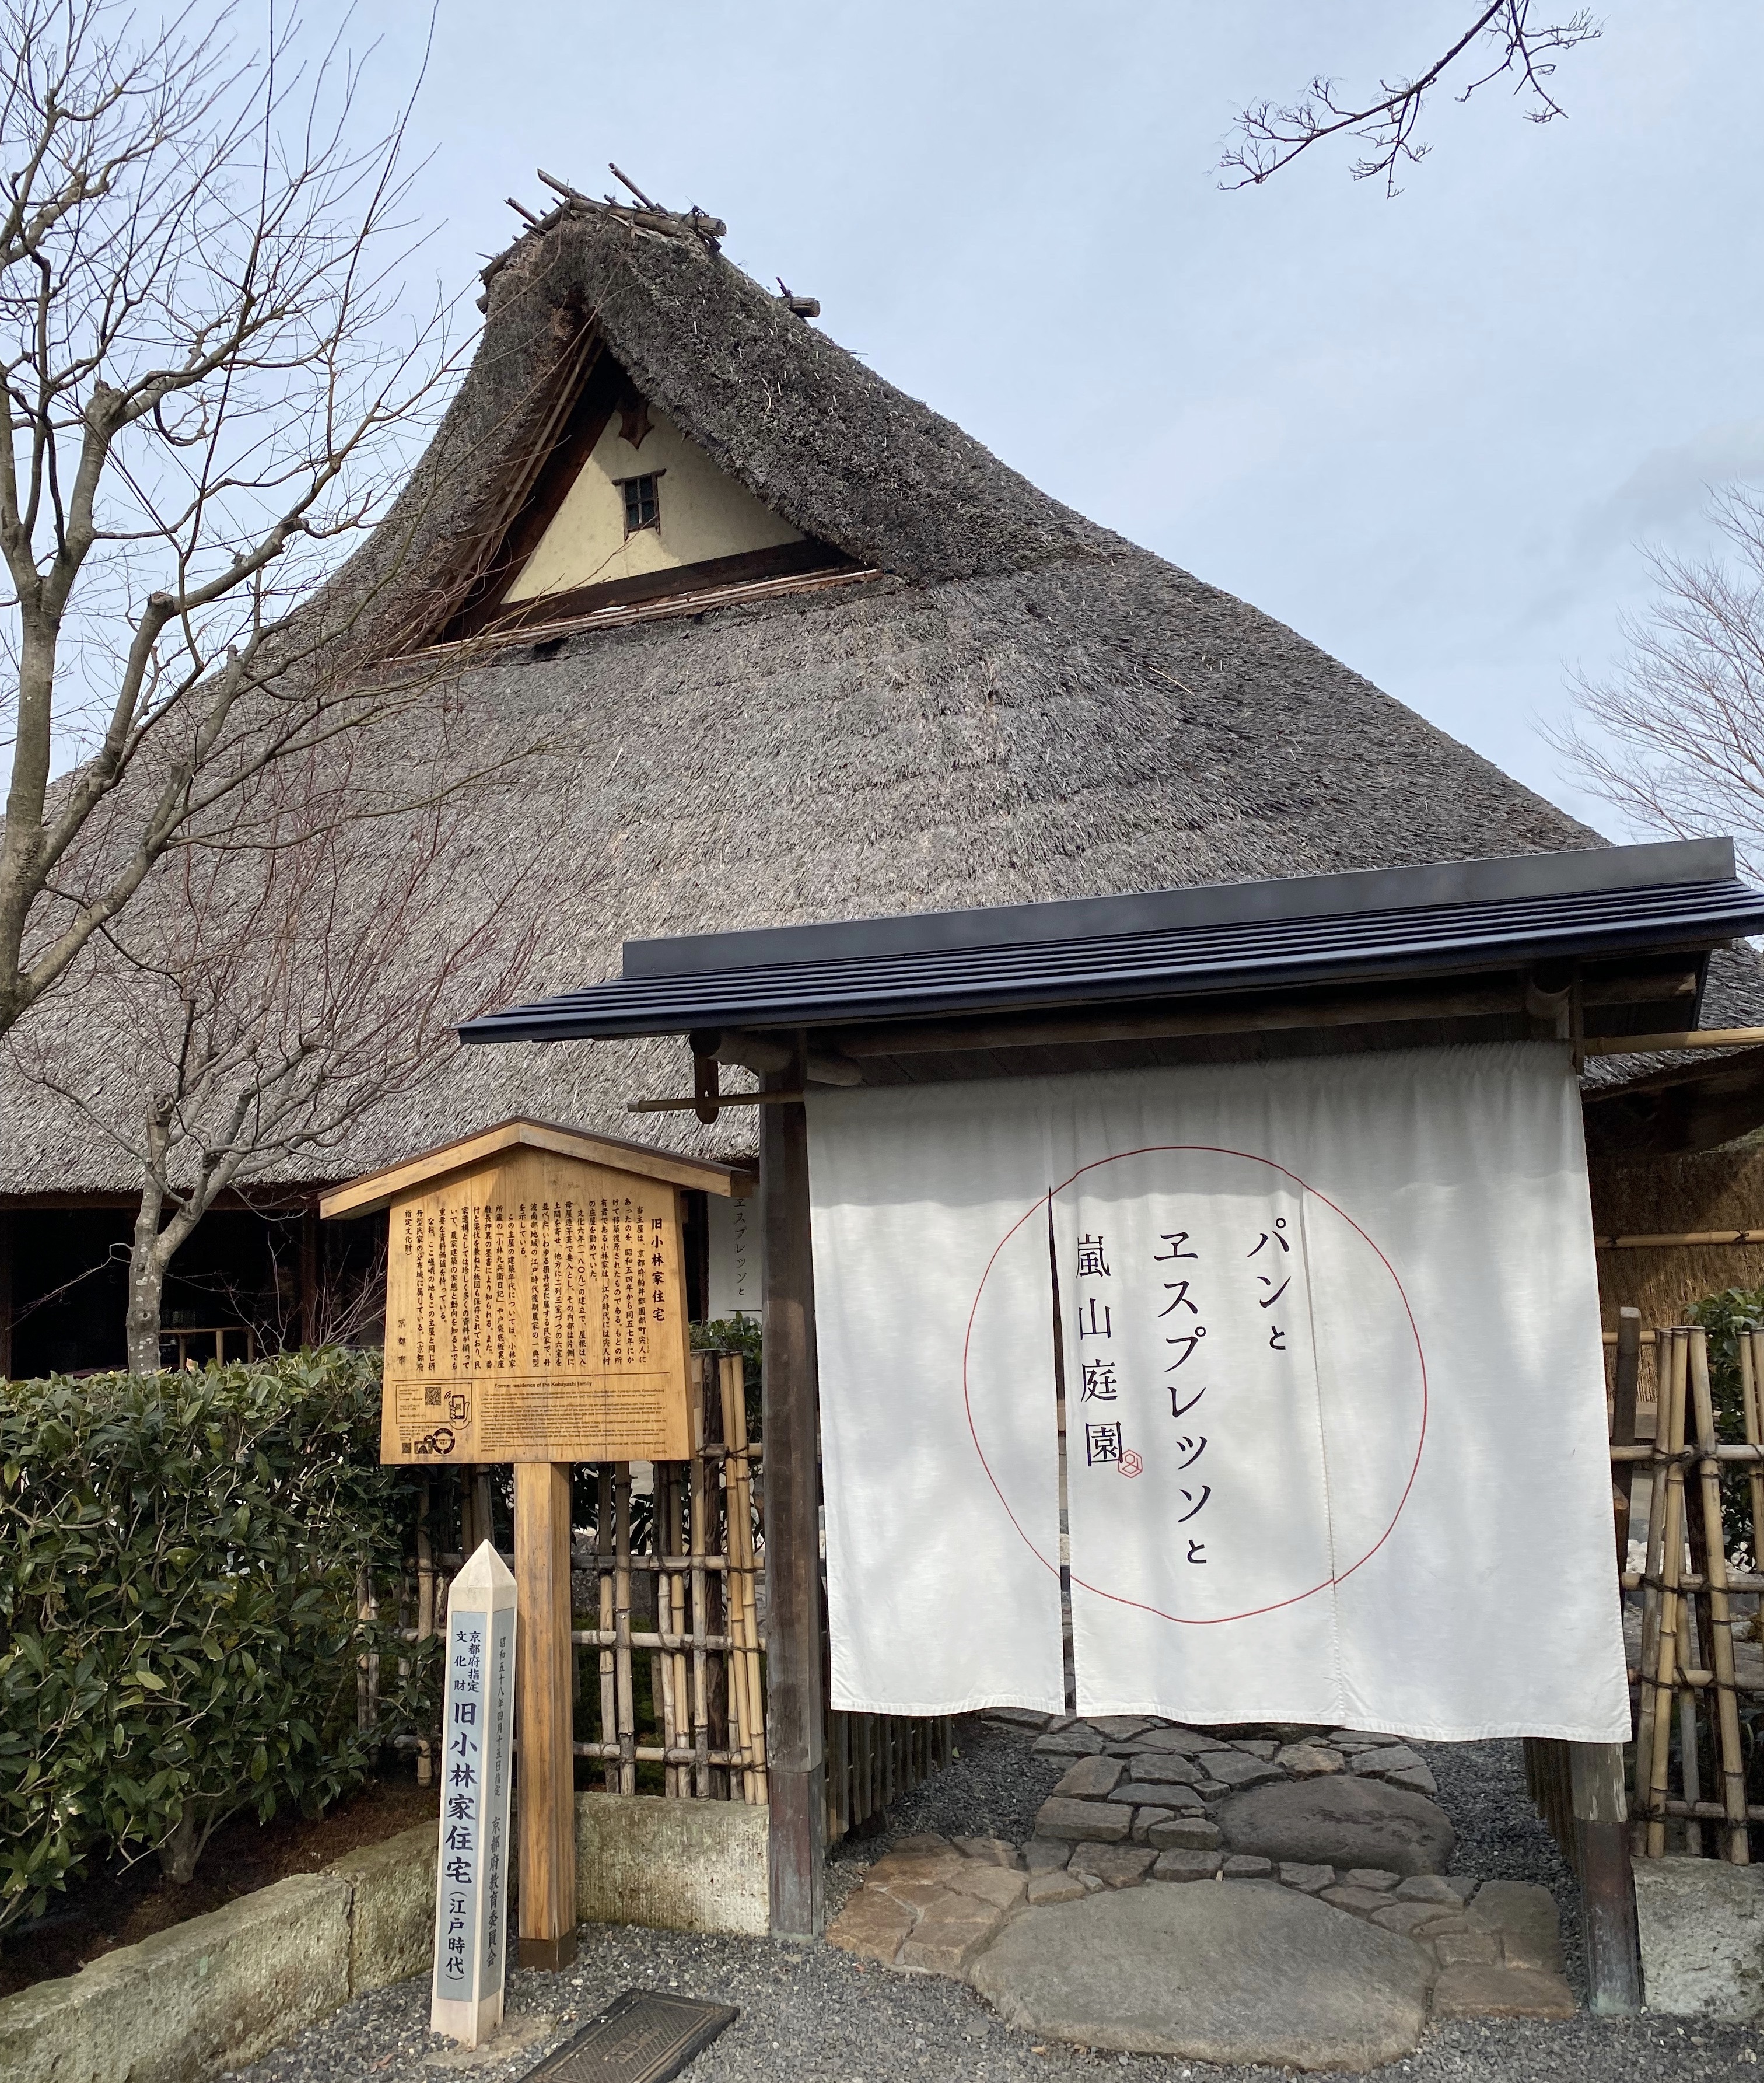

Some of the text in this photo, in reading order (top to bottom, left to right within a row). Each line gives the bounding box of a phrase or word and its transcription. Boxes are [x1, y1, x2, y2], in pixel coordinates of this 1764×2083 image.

[404, 1210, 412, 1256] 指定文化財）
[519, 1204, 527, 1258] を示している。
[589, 1200, 598, 1282] の庄屋を勤めていた。
[651, 1218, 665, 1322] 旧小林家住宅
[1247, 1218, 1292, 1350] パンと
[398, 1318, 406, 1366] 京都市
[1076, 1233, 1124, 1467] 嵐山庭園
[453, 1630, 467, 1691] 文化財
[467, 1630, 481, 1693] 京都府指定
[444, 1702, 478, 1980] 旧小林家住宅 （江戸時代）
[487, 1637, 506, 1968] 昭和五十八年四月十五日指定 京都府教育委員会
